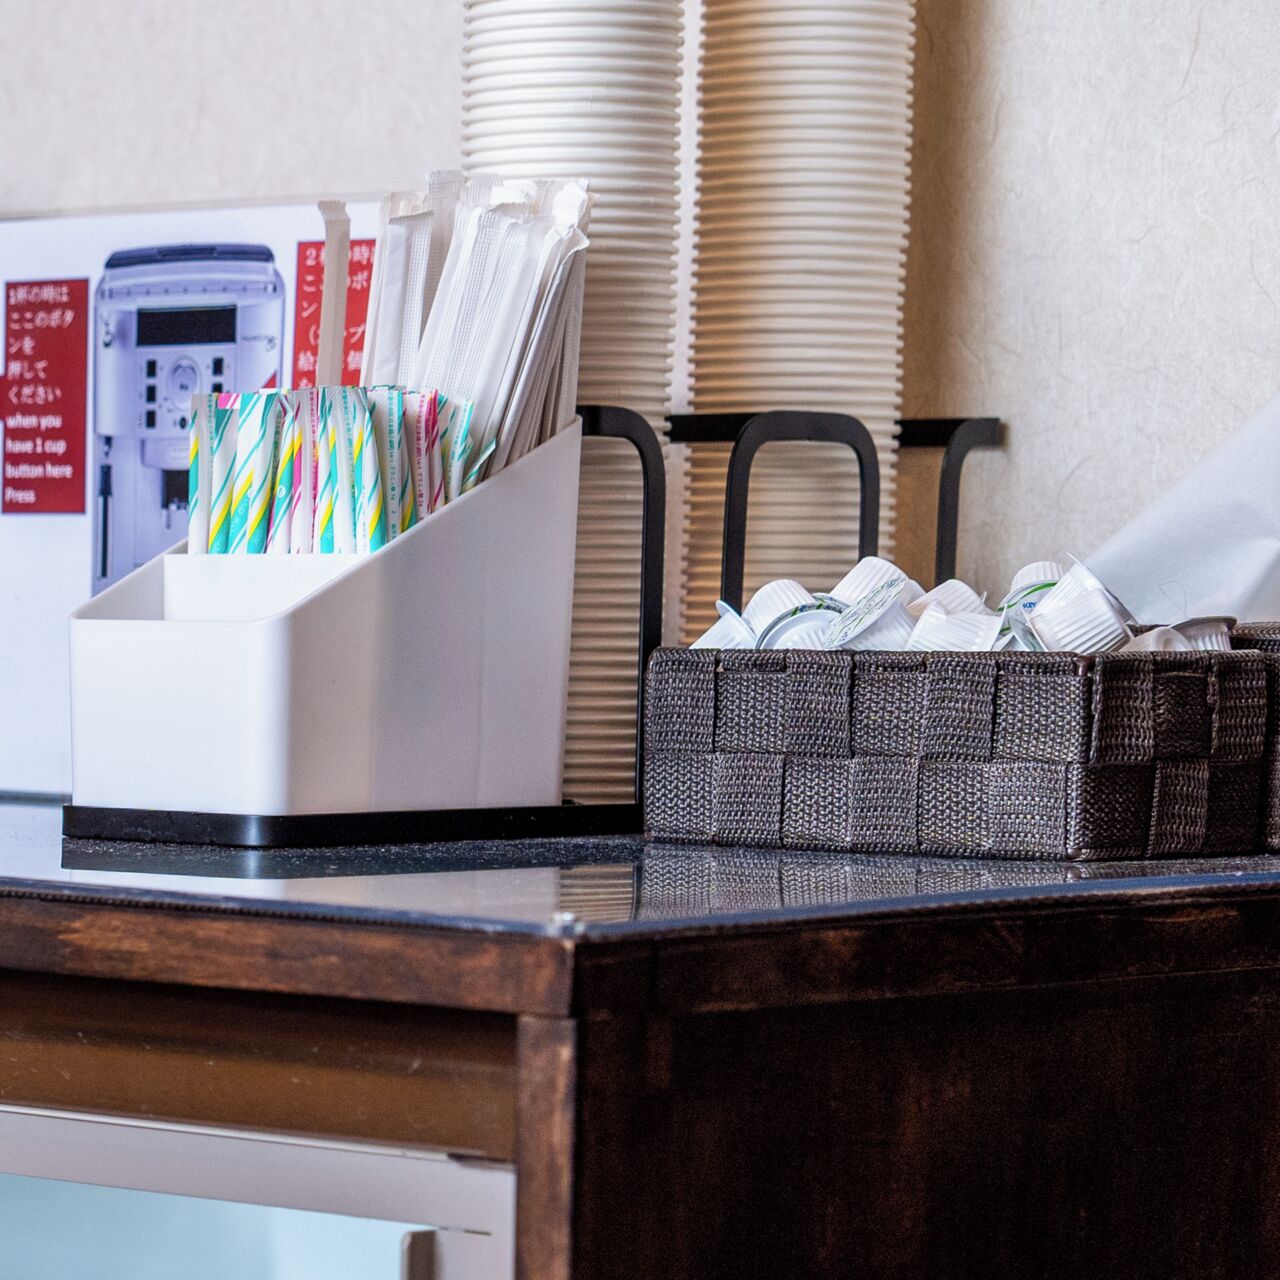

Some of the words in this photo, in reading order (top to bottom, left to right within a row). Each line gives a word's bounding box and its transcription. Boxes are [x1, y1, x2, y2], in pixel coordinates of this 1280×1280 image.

[6, 412, 38, 428] when
[40, 414, 62, 432] you
[5, 437, 34, 454] have
[44, 440, 67, 456] cup
[5, 461, 44, 479] button
[45, 461, 73, 478] here
[5, 487, 36, 504] Press
